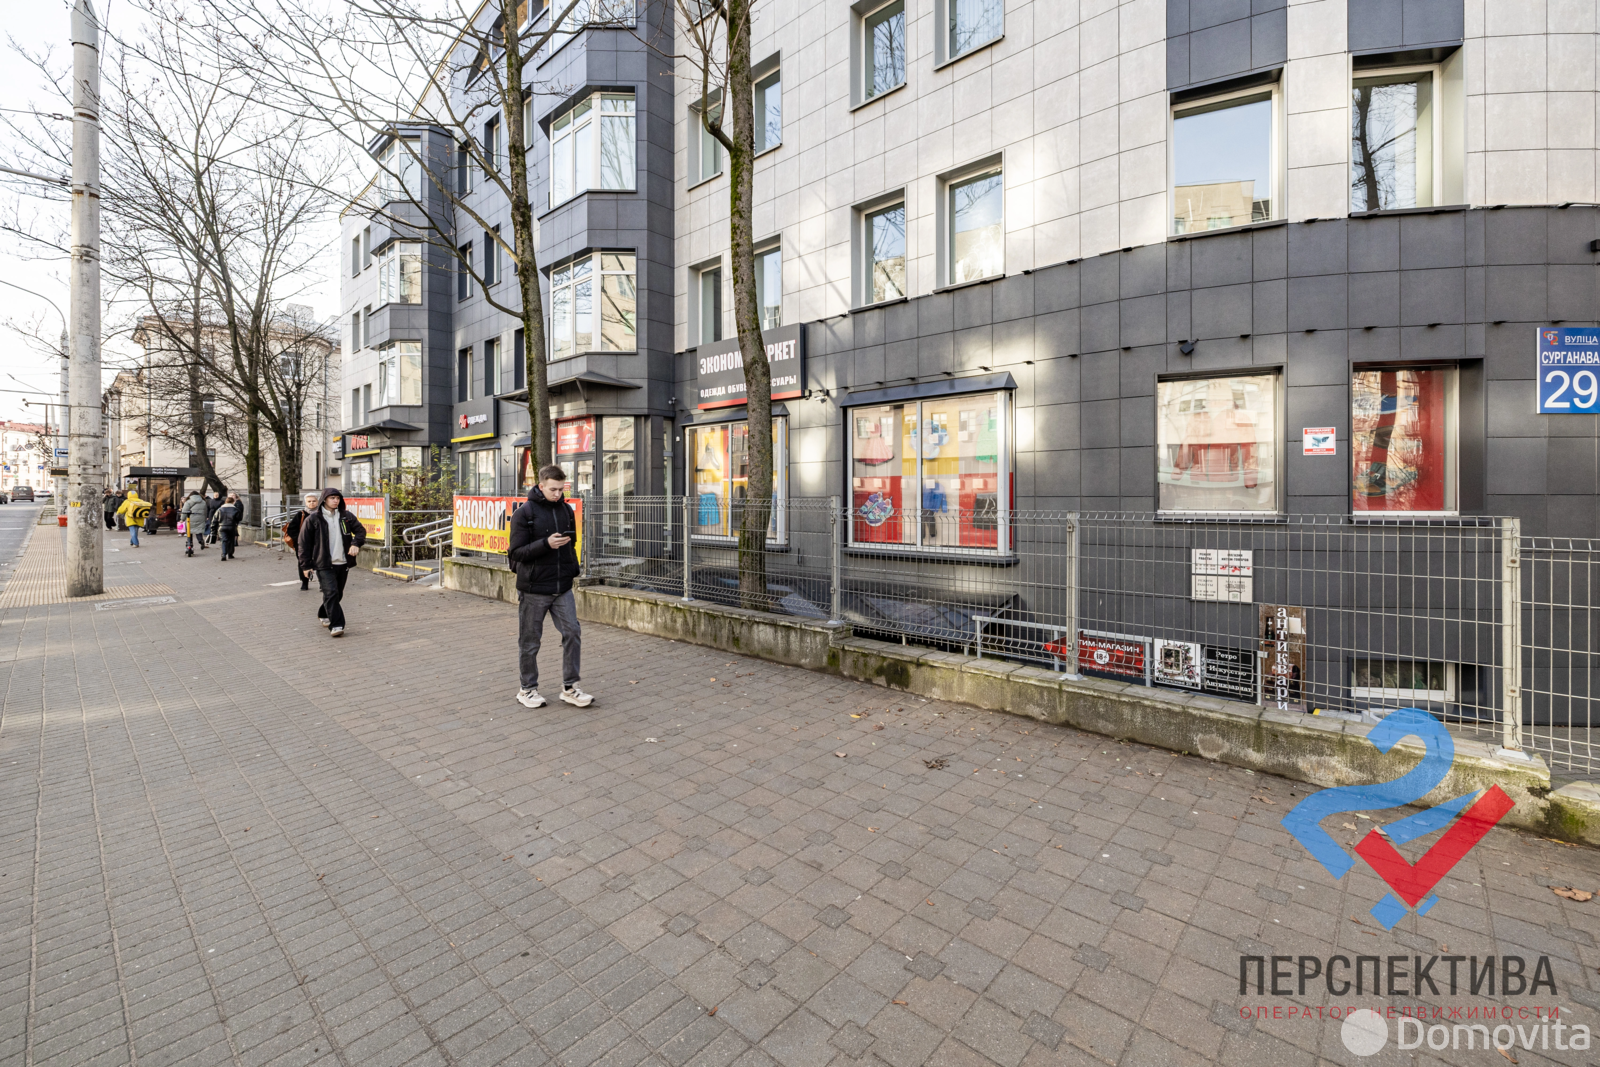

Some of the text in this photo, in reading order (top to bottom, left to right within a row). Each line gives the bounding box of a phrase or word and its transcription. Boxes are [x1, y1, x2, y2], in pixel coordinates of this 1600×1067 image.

[1565, 335, 1598, 344] ВУЛІЦА
[1542, 351, 1600, 364] СУРГАНАВА
[700, 386, 726, 398] ОДЕЖДА
[1544, 370, 1598, 409] 29
[460, 532, 485, 549] ОДЕЖДА
[489, 535, 510, 551] ОБУВЬ
[1078, 639, 1140, 653] ТИМ-МАГАЗИН
[1215, 651, 1238, 660] Ретро
